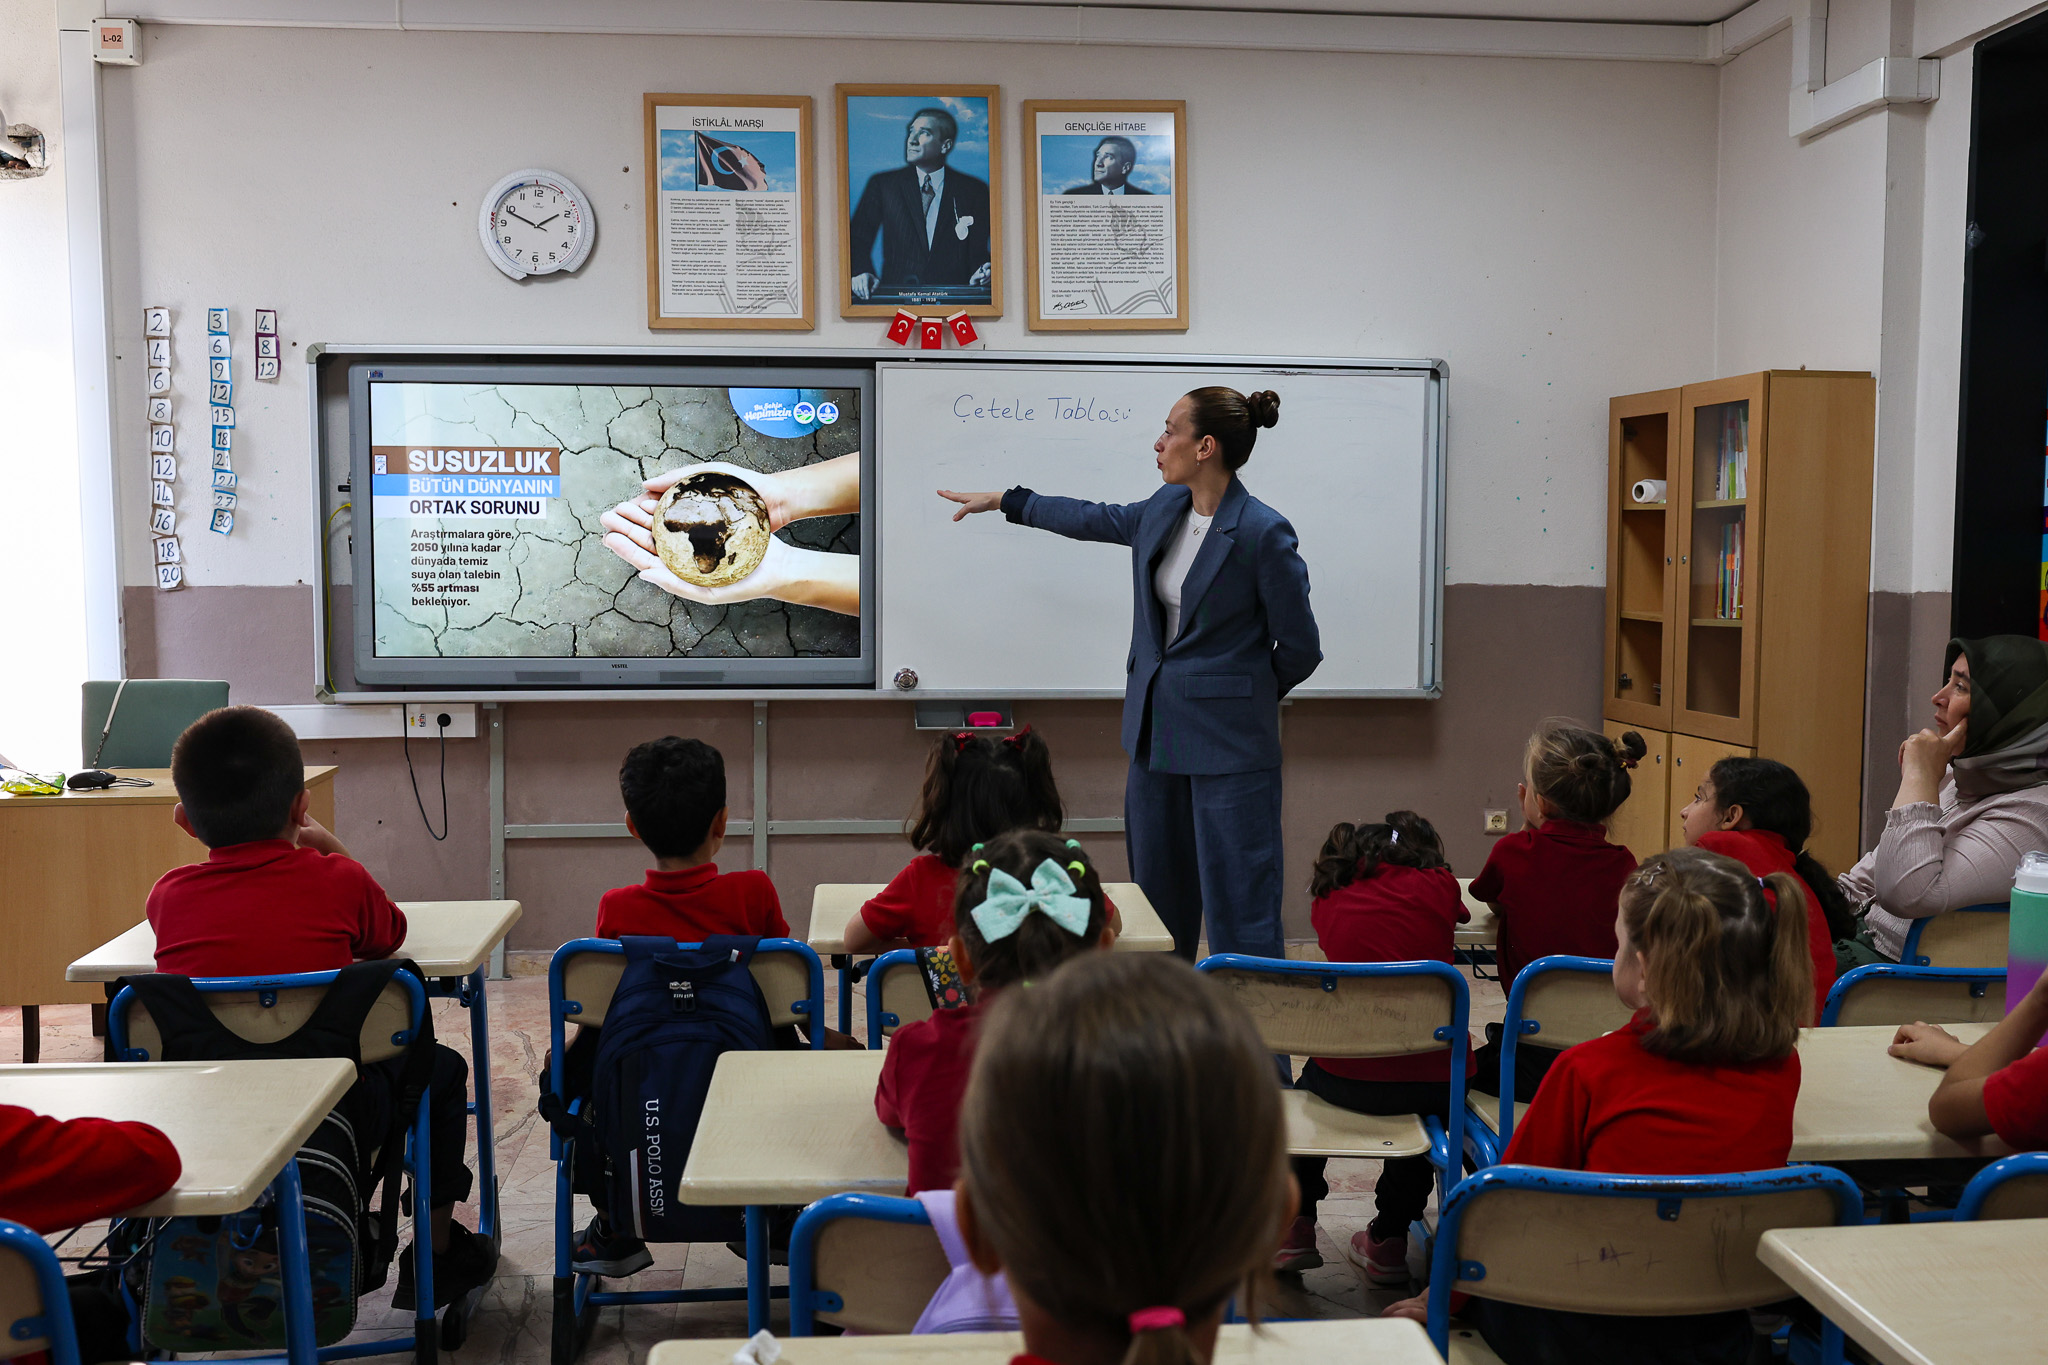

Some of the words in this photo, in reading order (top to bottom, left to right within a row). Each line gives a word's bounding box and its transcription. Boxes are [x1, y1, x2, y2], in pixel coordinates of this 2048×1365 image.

[692, 116, 732, 128] İSTİKLÂL
[735, 119, 764, 129] MARŞI
[1065, 121, 1112, 133] GENÇLİĞE
[1114, 122, 1146, 131] HİTABE
[506, 205, 516, 213] 10
[564, 210, 571, 218] 2
[504, 236, 511, 244] 8
[516, 249, 522, 257] 7
[549, 252, 556, 260] 5
[151, 313, 163, 331] 2
[212, 313, 222, 329] 3
[258, 315, 270, 331] 4
[153, 343, 165, 362] 4
[212, 338, 222, 353] 6
[261, 339, 271, 354] 8
[214, 362, 223, 378] 9
[260, 361, 275, 376] 12
[153, 371, 163, 389] 6
[213, 384, 227, 400] 12
[154, 402, 165, 419] 8
[215, 407, 230, 423] 15
[744, 407, 792, 421] Hepimizin
[953, 393, 1034, 423] Çetele
[155, 429, 171, 447] 10
[217, 430, 228, 446] 18
[155, 458, 173, 476] 12
[215, 453, 229, 466] 21
[408, 449, 552, 473] SUSUZLUK
[155, 484, 170, 502] 14
[409, 478, 464, 494] BÜTÜN
[468, 479, 553, 494] DÜNYANIN
[215, 495, 234, 507] 27
[410, 500, 466, 514] ORTAK
[470, 501, 540, 514] SORUNU
[155, 512, 170, 529] 16
[215, 514, 231, 528] 30
[410, 529, 485, 540] Araştırmalara
[487, 530, 515, 540] göre,
[161, 542, 174, 557] 18
[410, 543, 439, 552] 2050
[441, 543, 469, 554] yılına
[471, 543, 502, 552] kadar
[411, 556, 456, 567] dünyada
[459, 557, 489, 566] temiz
[161, 566, 179, 583] 20
[411, 571, 436, 581] suya
[438, 570, 461, 579] olan
[464, 570, 501, 579] talebin
[411, 583, 435, 592] %55
[437, 584, 479, 593] artması
[411, 597, 471, 608] bekleniyor.
[645, 1098, 660, 1130] U.S.
[646, 1134, 661, 1174] POLO
